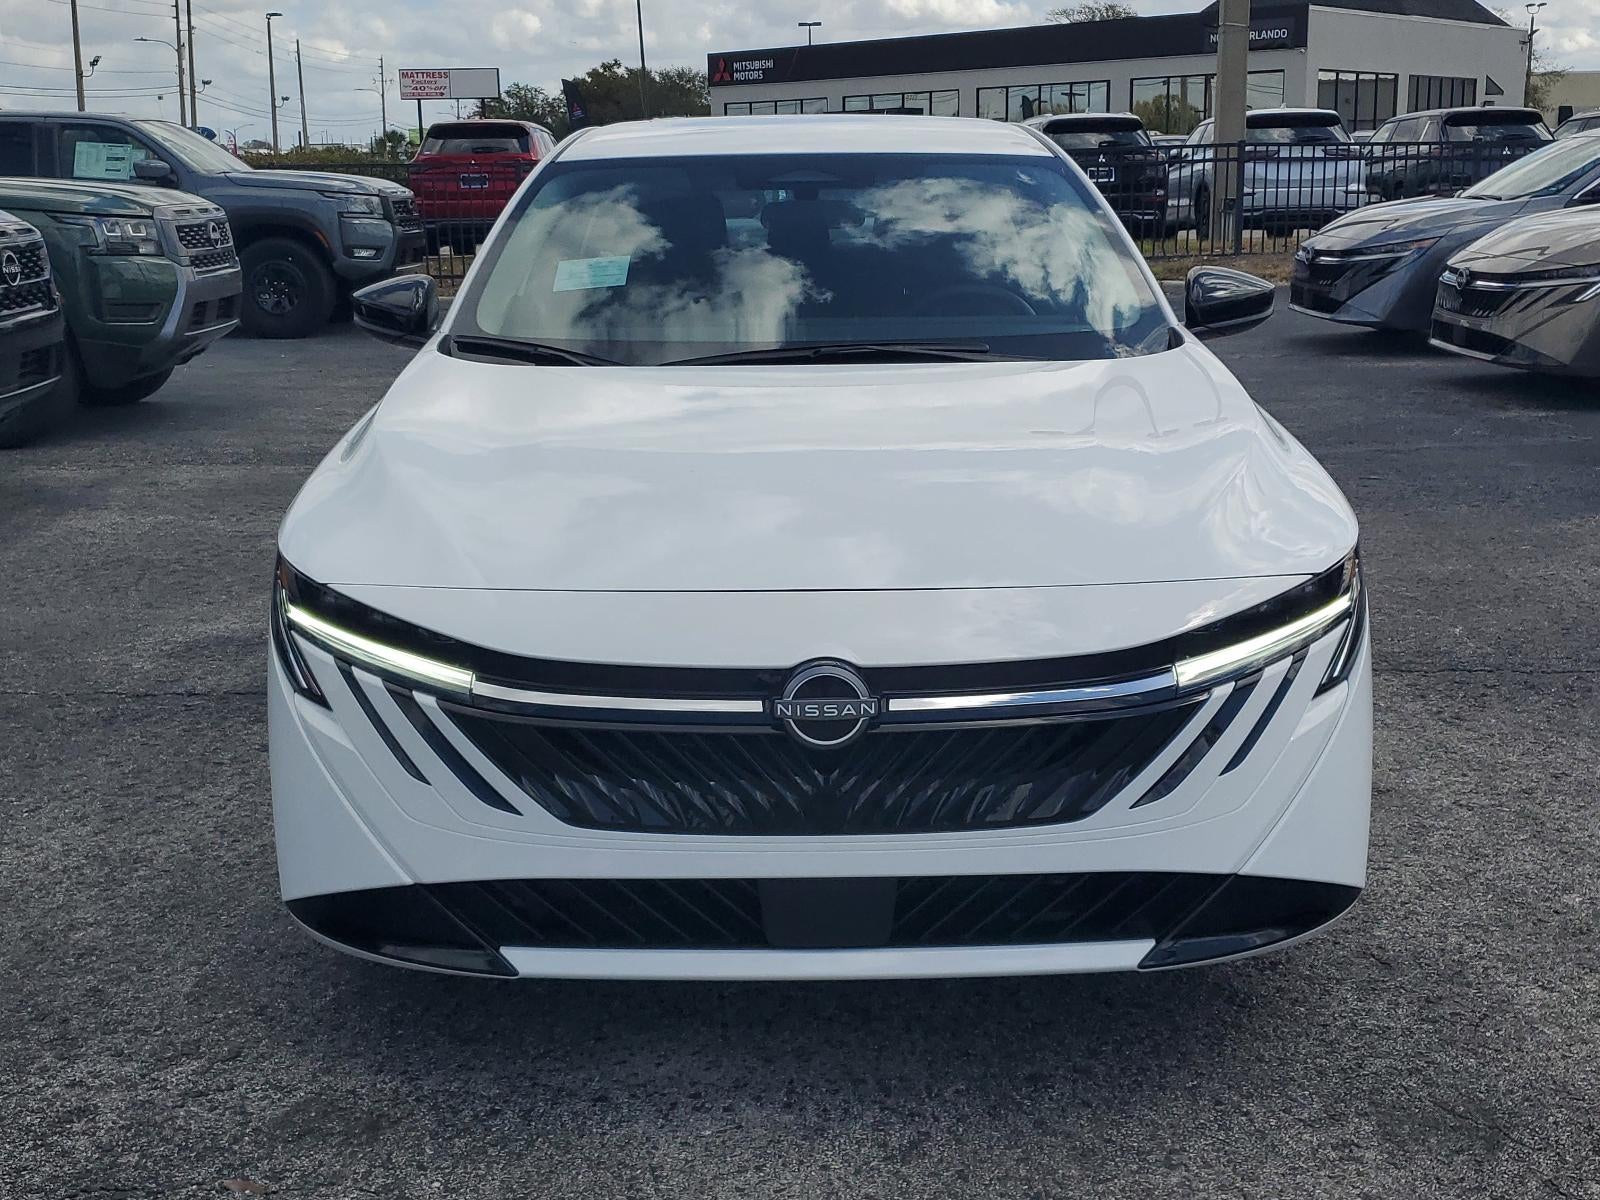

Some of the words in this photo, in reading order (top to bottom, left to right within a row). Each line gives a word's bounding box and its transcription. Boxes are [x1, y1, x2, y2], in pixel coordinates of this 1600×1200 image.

[1249, 29, 1288, 41] RLANDO
[733, 59, 774, 71] MITSUBISHI
[401, 71, 449, 79] MATTRESS
[733, 71, 764, 81] MOTORS
[777, 702, 876, 717] NISSAN
